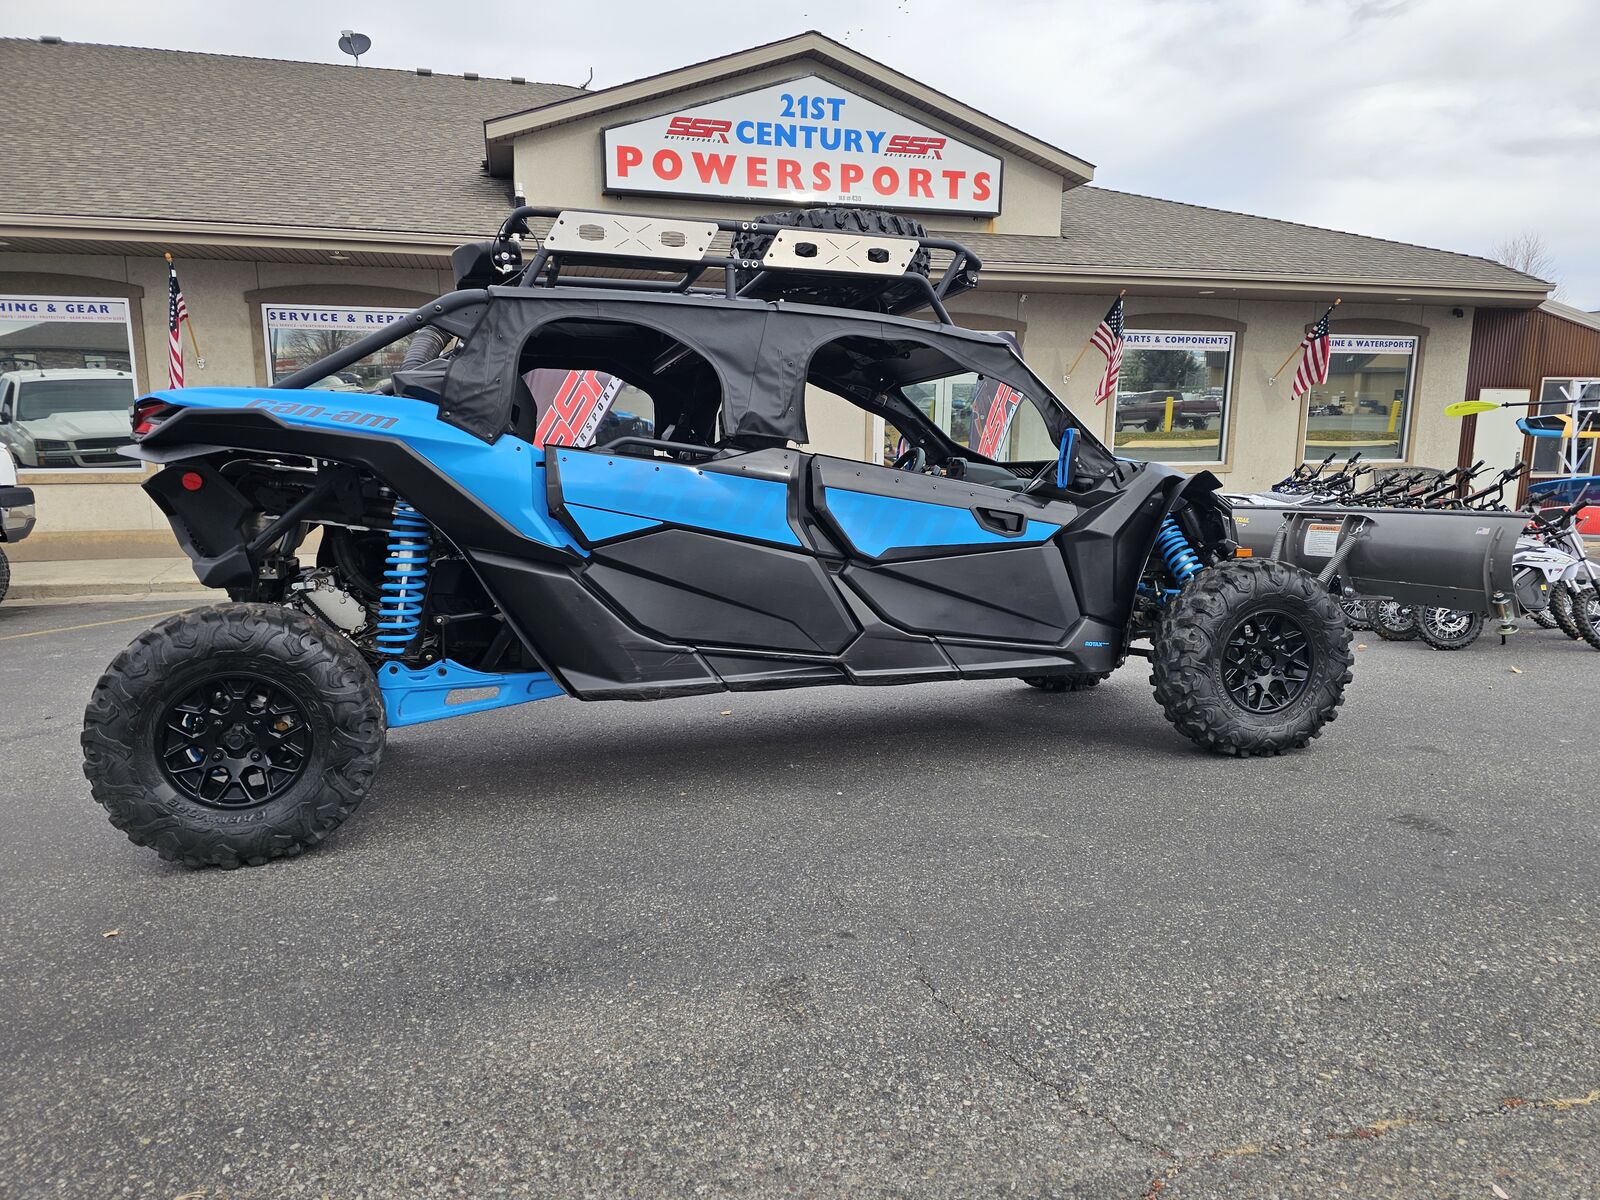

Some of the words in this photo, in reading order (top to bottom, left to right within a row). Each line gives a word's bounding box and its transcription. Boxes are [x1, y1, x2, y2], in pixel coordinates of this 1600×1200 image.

[780, 93, 846, 121] 21ST
[664, 135, 721, 143] MOTORSPORTS
[665, 116, 733, 145] SSR
[735, 120, 887, 154] CENTURY
[883, 152, 935, 160] MOTORSPORTS
[885, 134, 947, 161] SSR
[616, 144, 992, 201] POWERSPORTS
[47, 303, 57, 313] &
[65, 303, 110, 314] GEAR
[269, 311, 338, 323] SERVICE
[346, 313, 356, 323] &
[1154, 335, 1161, 343] &
[1164, 335, 1229, 345] COMPONENTS
[1347, 339, 1353, 347] &
[1356, 340, 1413, 349] WATERSPORTS
[245, 398, 400, 430] can-am
